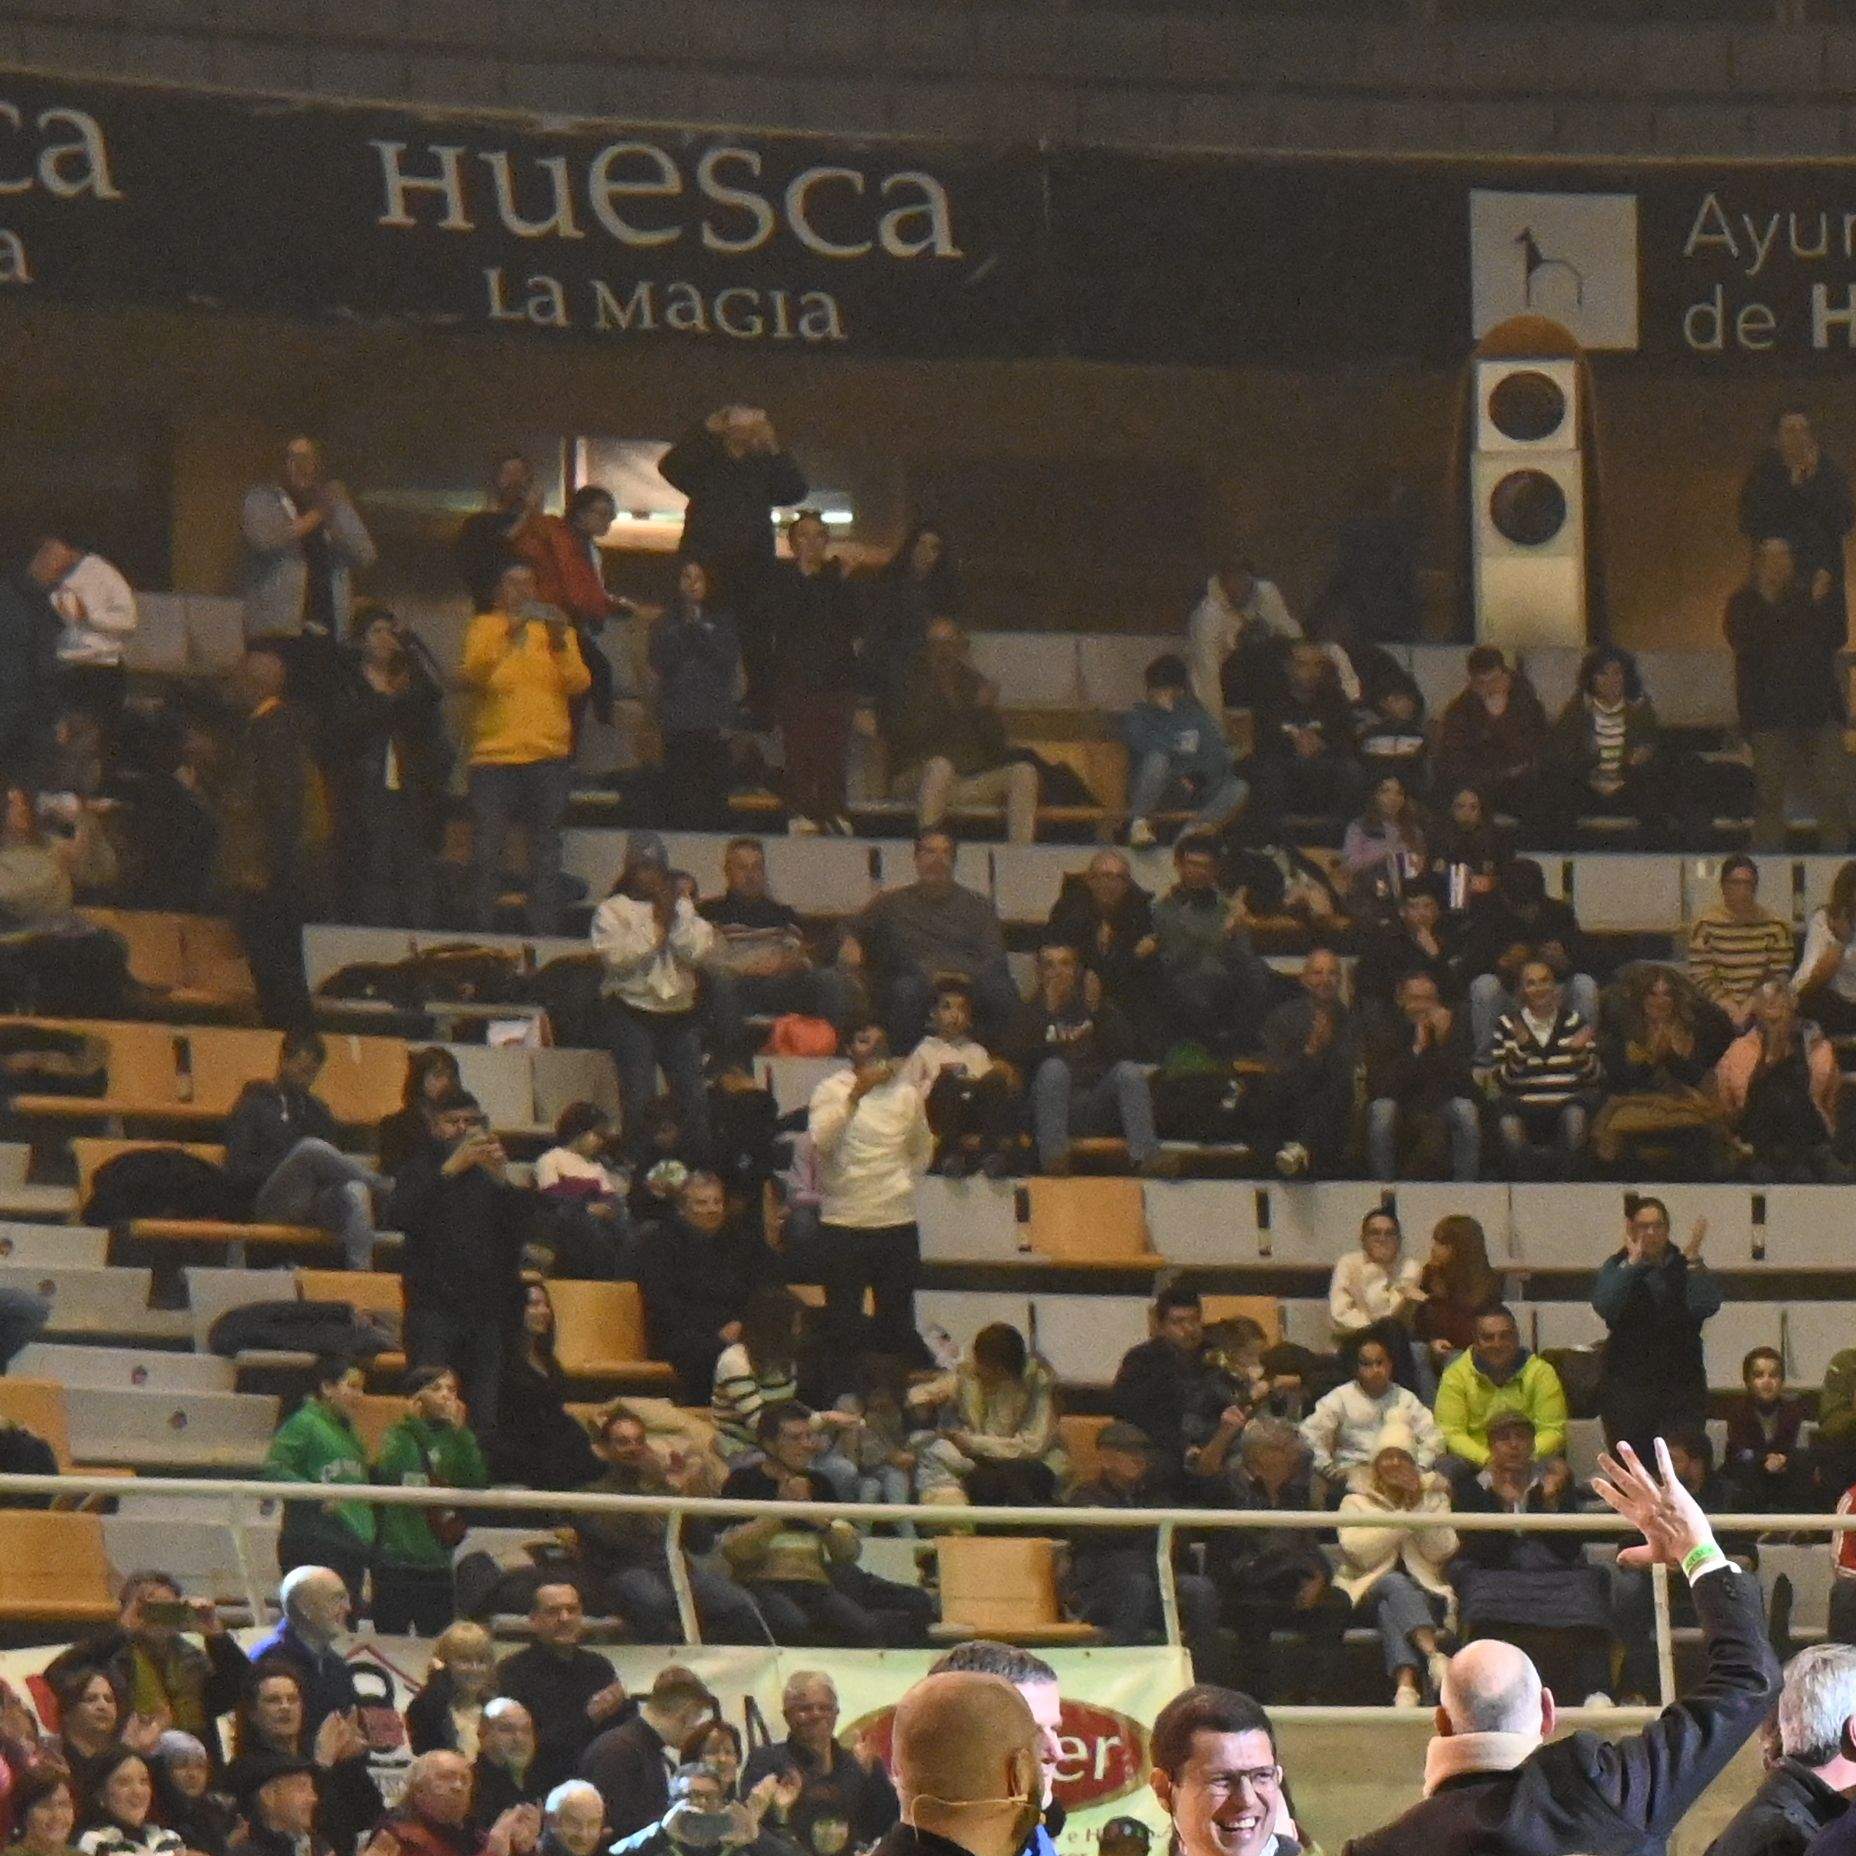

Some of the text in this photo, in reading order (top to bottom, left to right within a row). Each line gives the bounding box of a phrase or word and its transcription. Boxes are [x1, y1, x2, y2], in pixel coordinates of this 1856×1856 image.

[370, 140, 964, 259] Huesca
[484, 267, 570, 328] La
[1683, 284, 1777, 351] de
